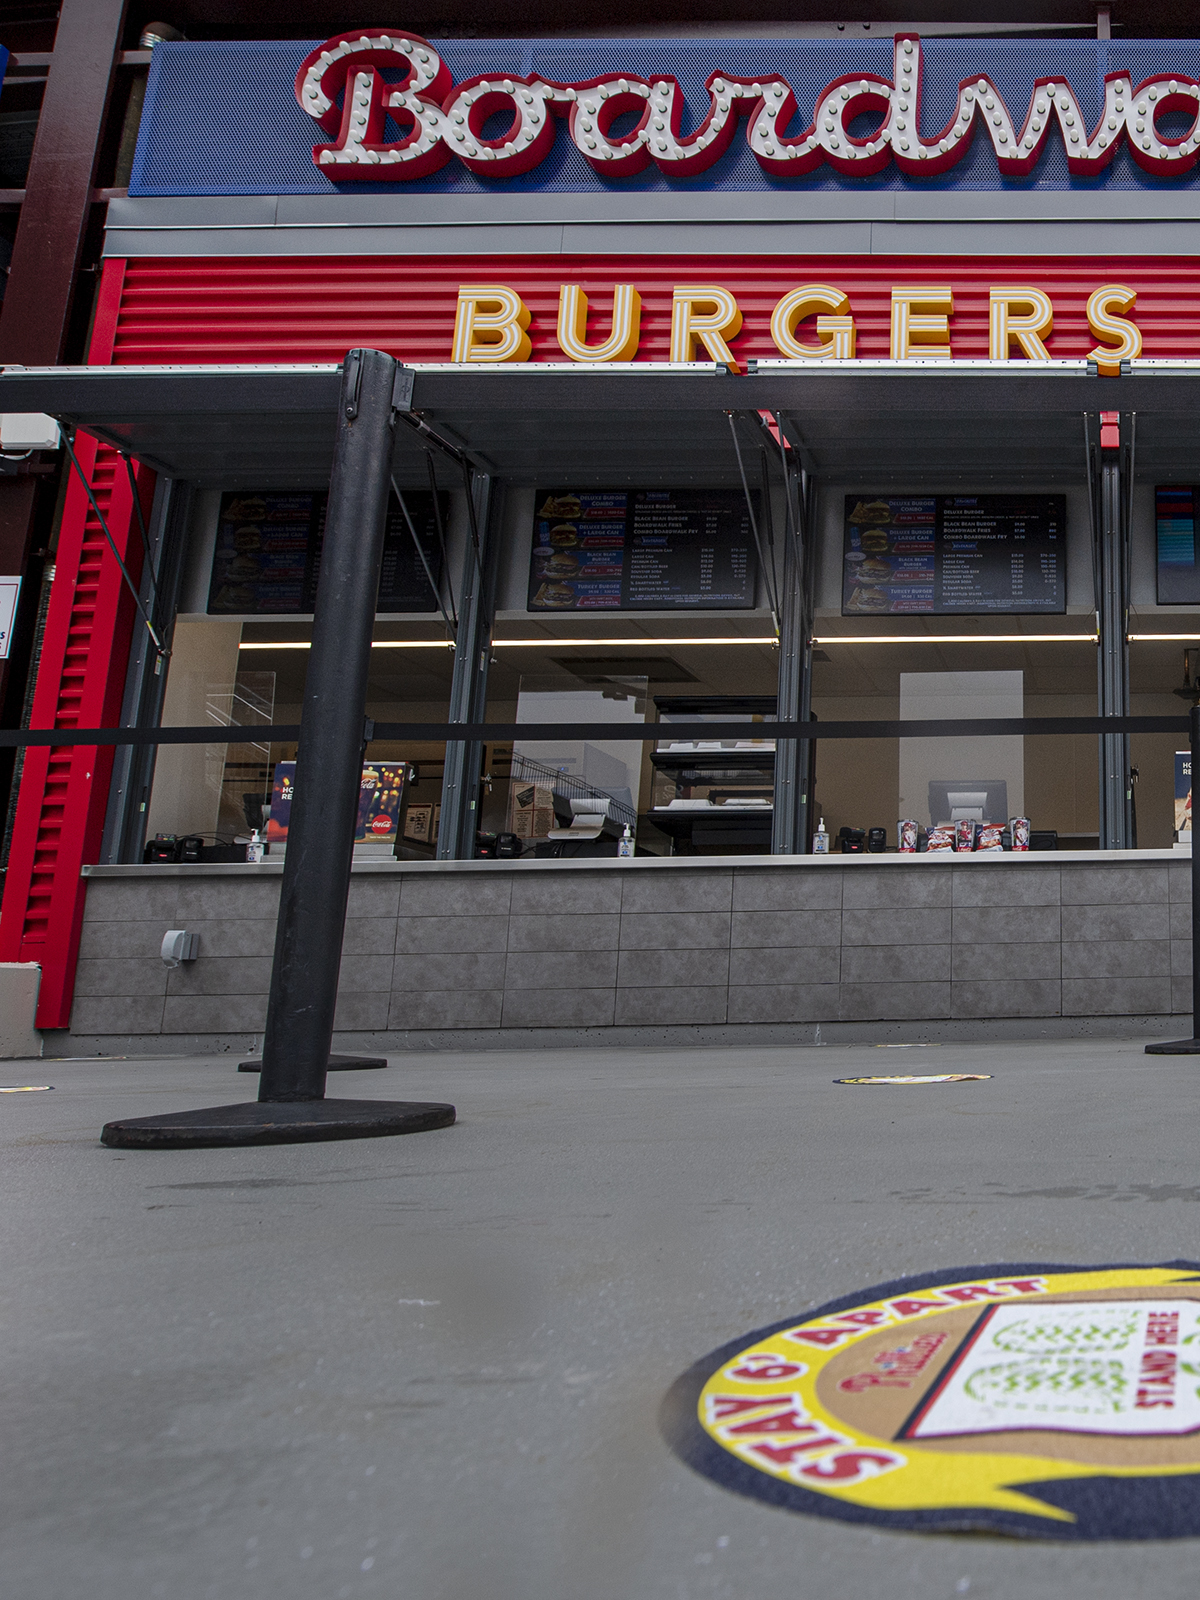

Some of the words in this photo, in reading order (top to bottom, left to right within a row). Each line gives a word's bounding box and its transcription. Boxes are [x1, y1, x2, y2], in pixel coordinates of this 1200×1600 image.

[450, 284, 1142, 372] BURGERS
[783, 1277, 1049, 1351] APART
[1144, 1310, 1180, 1347] HERE
[1135, 1351, 1177, 1410] STAND
[705, 1392, 908, 1487] STAY
